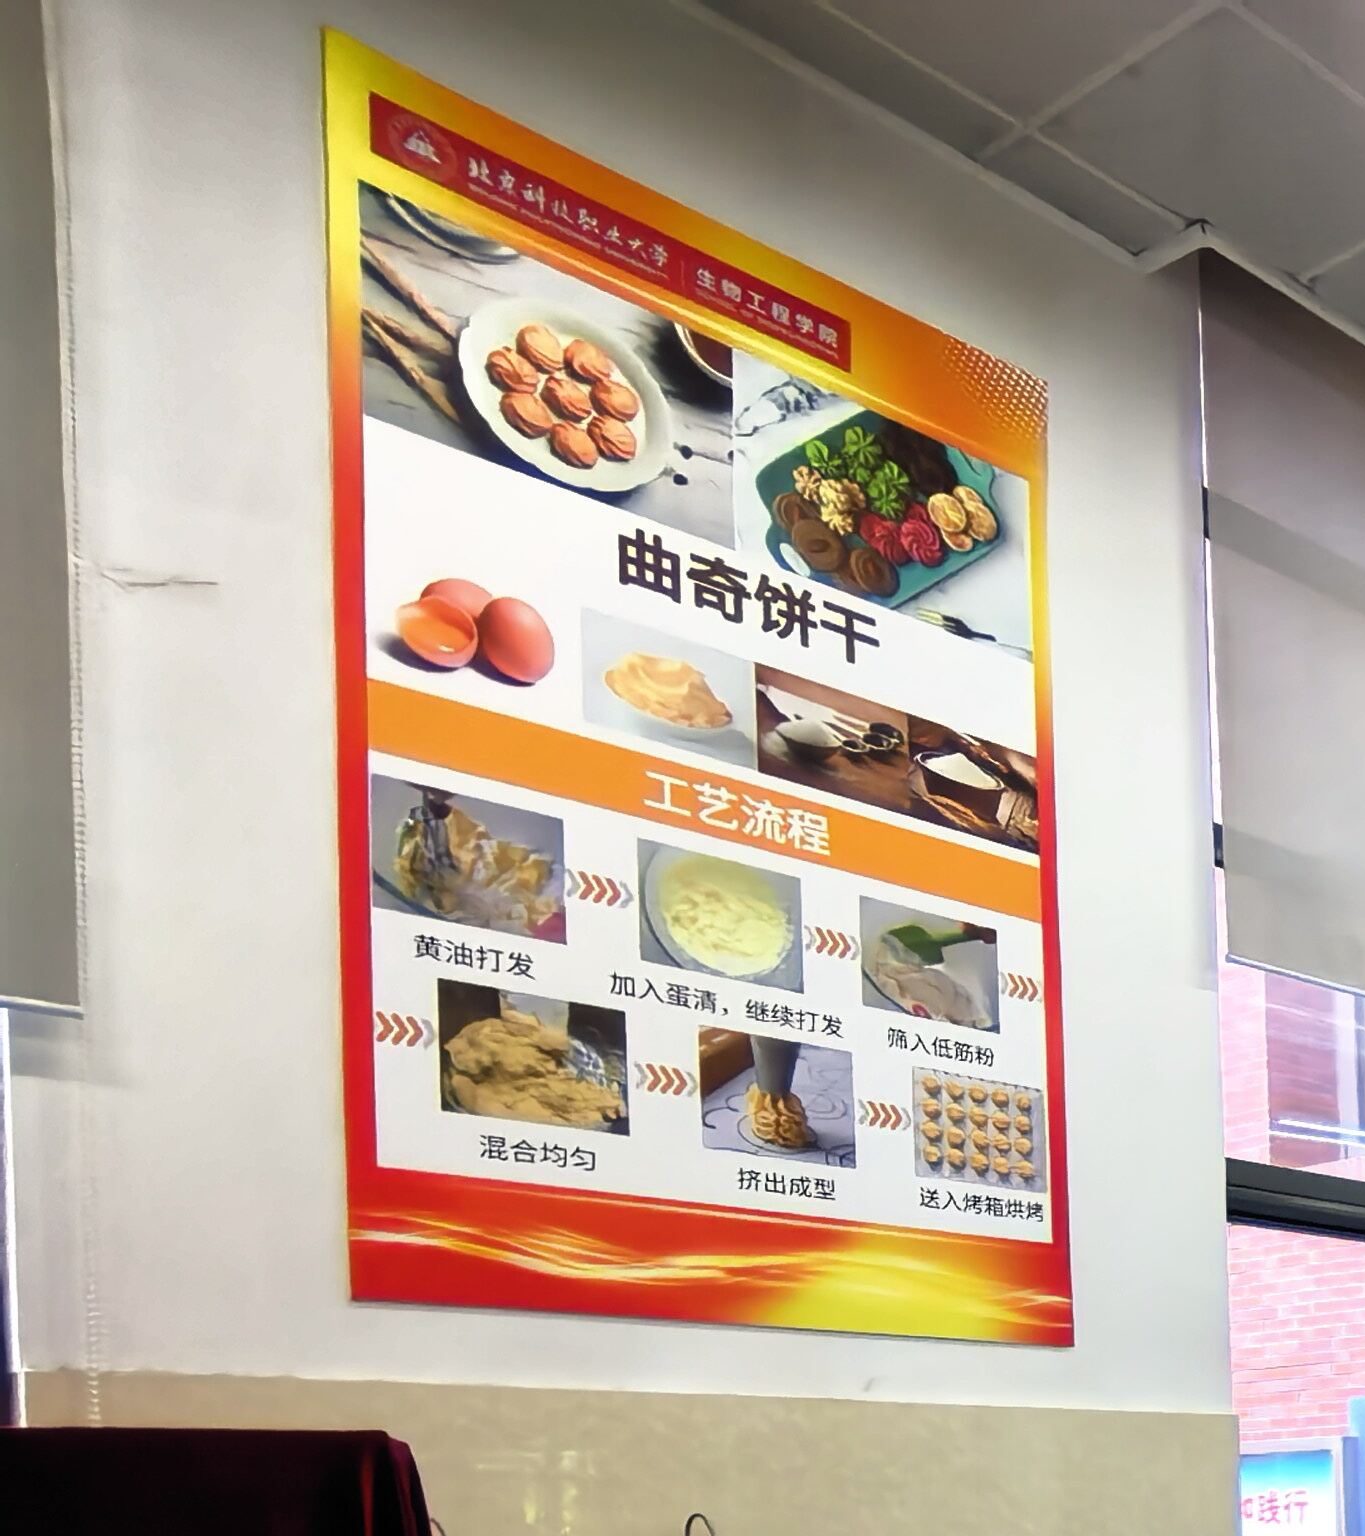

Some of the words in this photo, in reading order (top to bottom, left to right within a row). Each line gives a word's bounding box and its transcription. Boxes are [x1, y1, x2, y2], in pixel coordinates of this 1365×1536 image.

[696, 266, 839, 348] 生物工程学院
[618, 527, 881, 664] 曲奇饼干
[643, 770, 832, 857] 工艺流程
[413, 933, 536, 981] 黄油打发
[886, 1026, 996, 1069] 筛入低筋粉
[478, 1133, 598, 1173] 混合均匀
[736, 1168, 837, 1202] 挤出成型
[918, 1186, 1045, 1224] 送入烤箱烘烤
